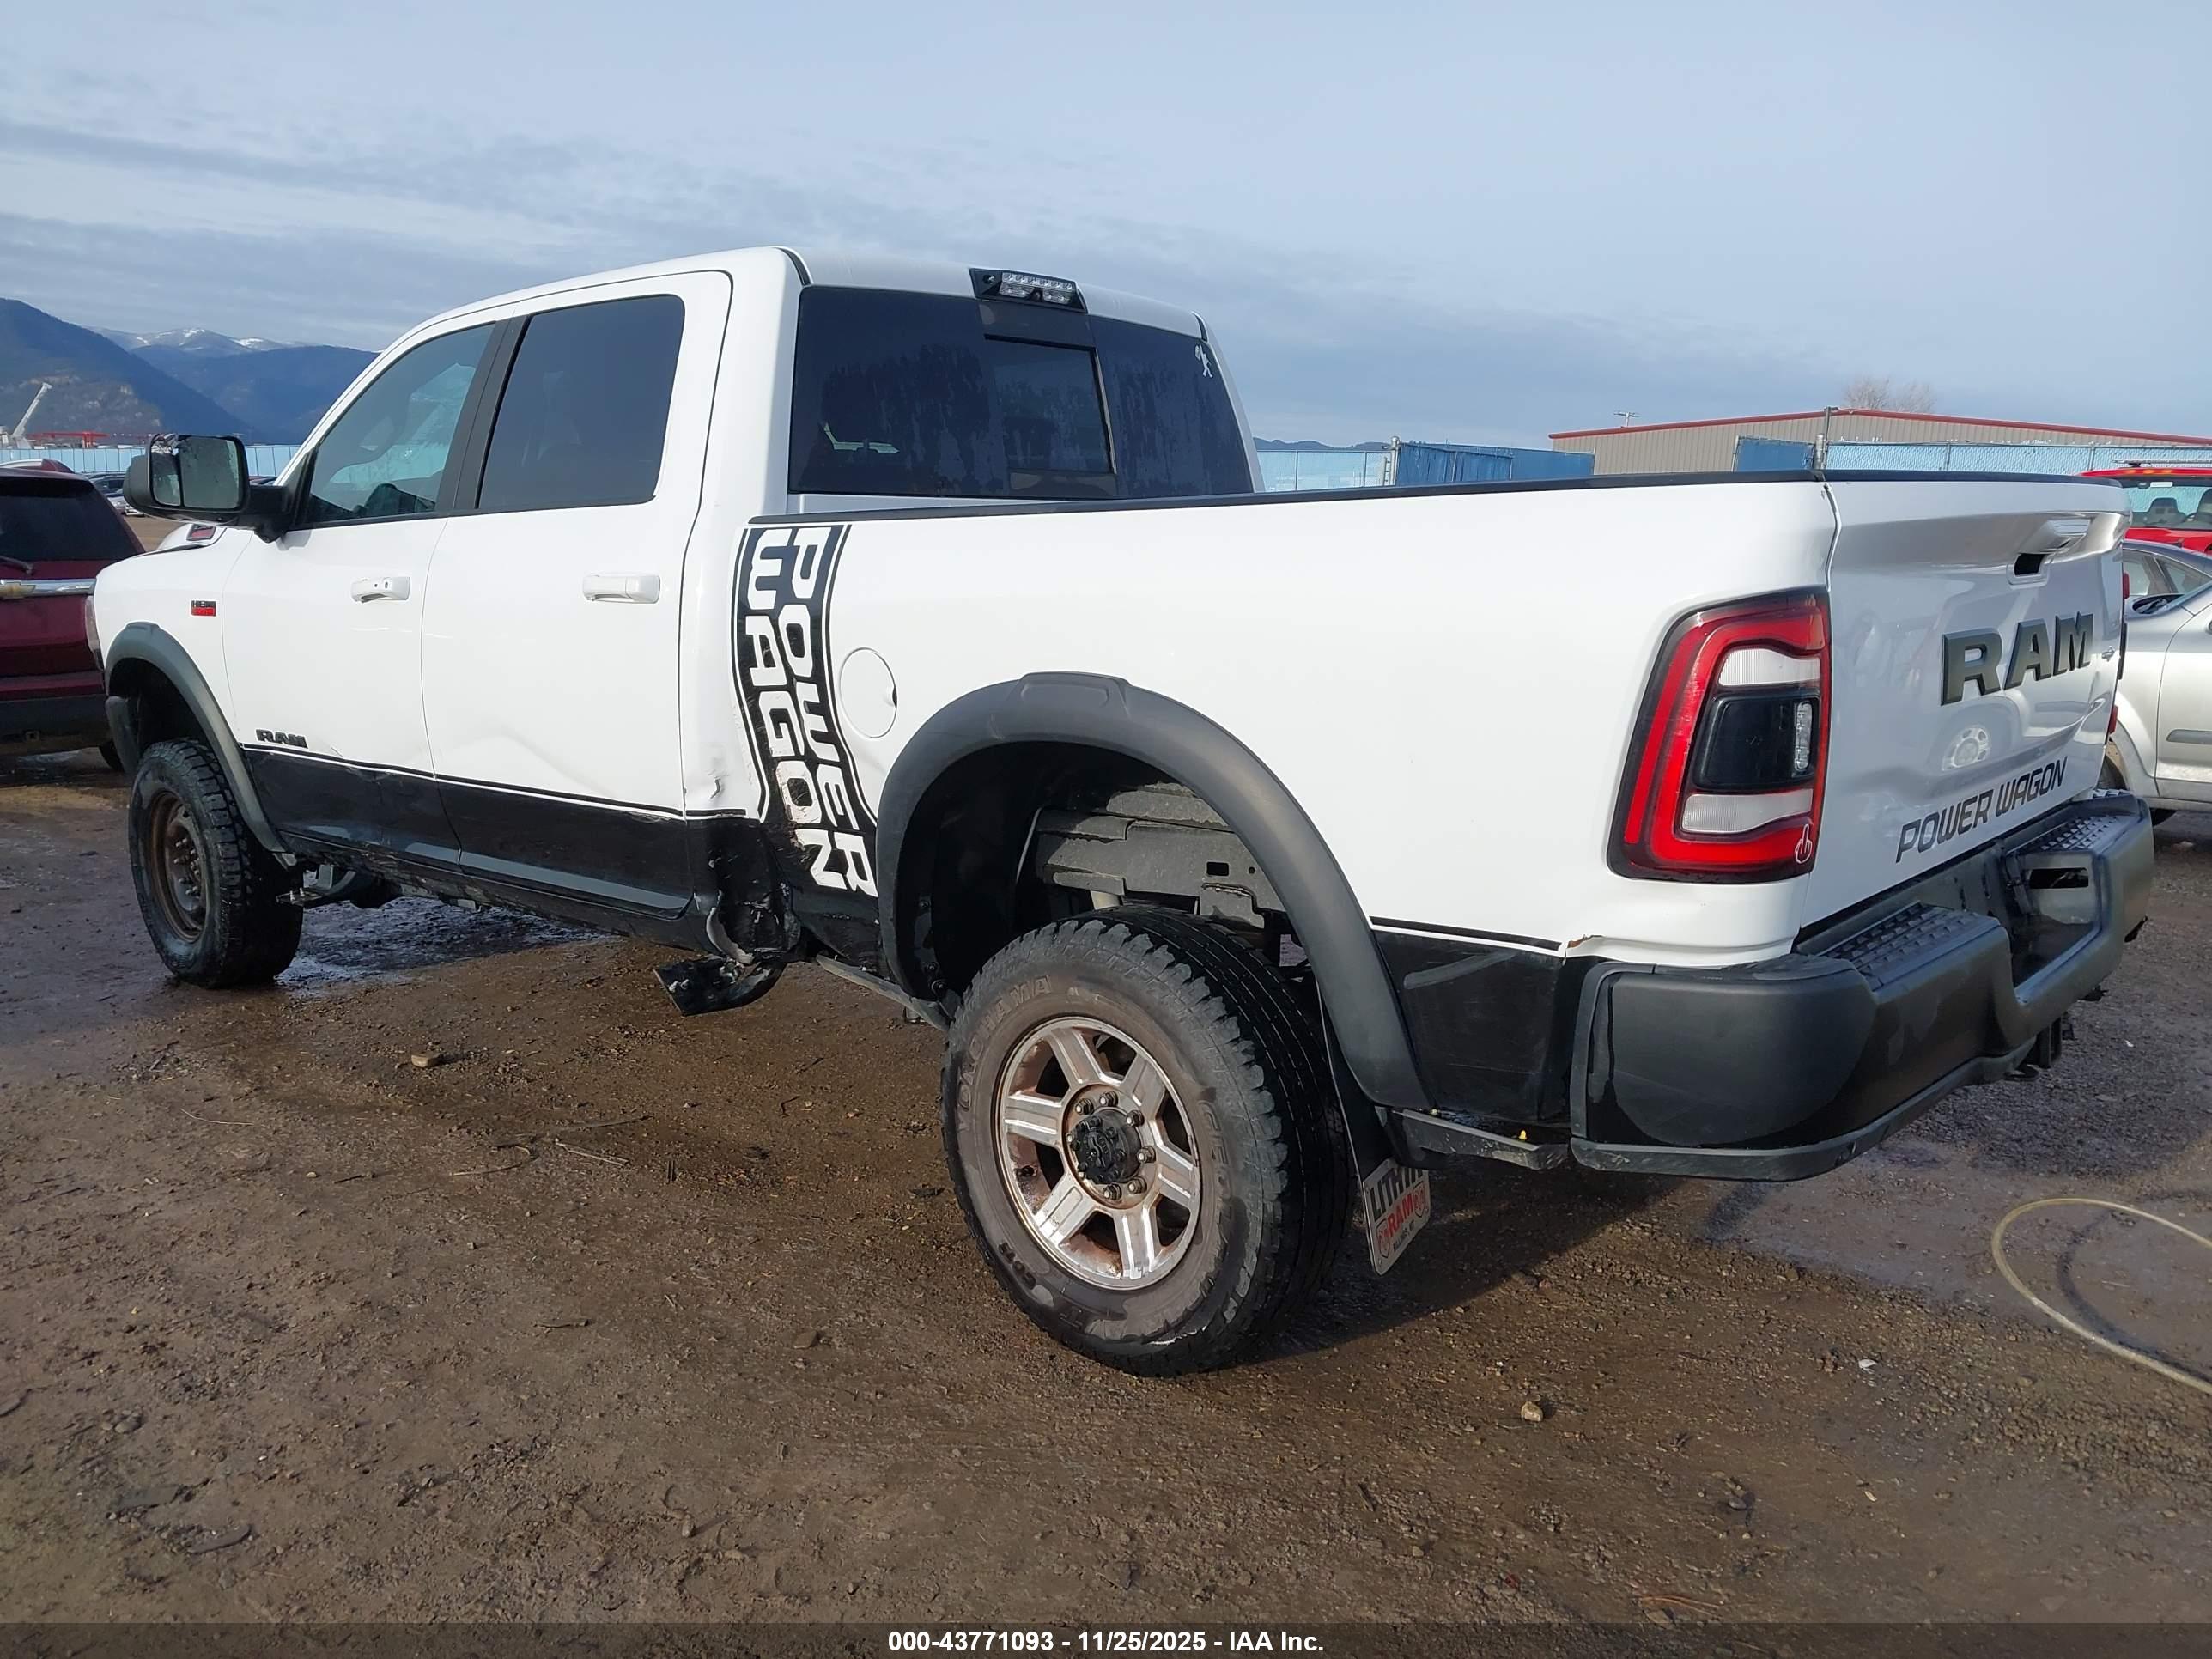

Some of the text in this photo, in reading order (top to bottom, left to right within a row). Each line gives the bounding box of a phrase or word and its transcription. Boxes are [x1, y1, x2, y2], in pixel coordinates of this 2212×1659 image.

[745, 528, 848, 890] WAGON
[779, 526, 879, 898] POWER
[1940, 611, 2094, 707] RAM
[255, 728, 309, 750] RAM
[1895, 756, 2069, 864] POWER WAGON
[957, 975, 1052, 1133] YOKOHAMA
[1387, 1193, 1414, 1238] RAM
